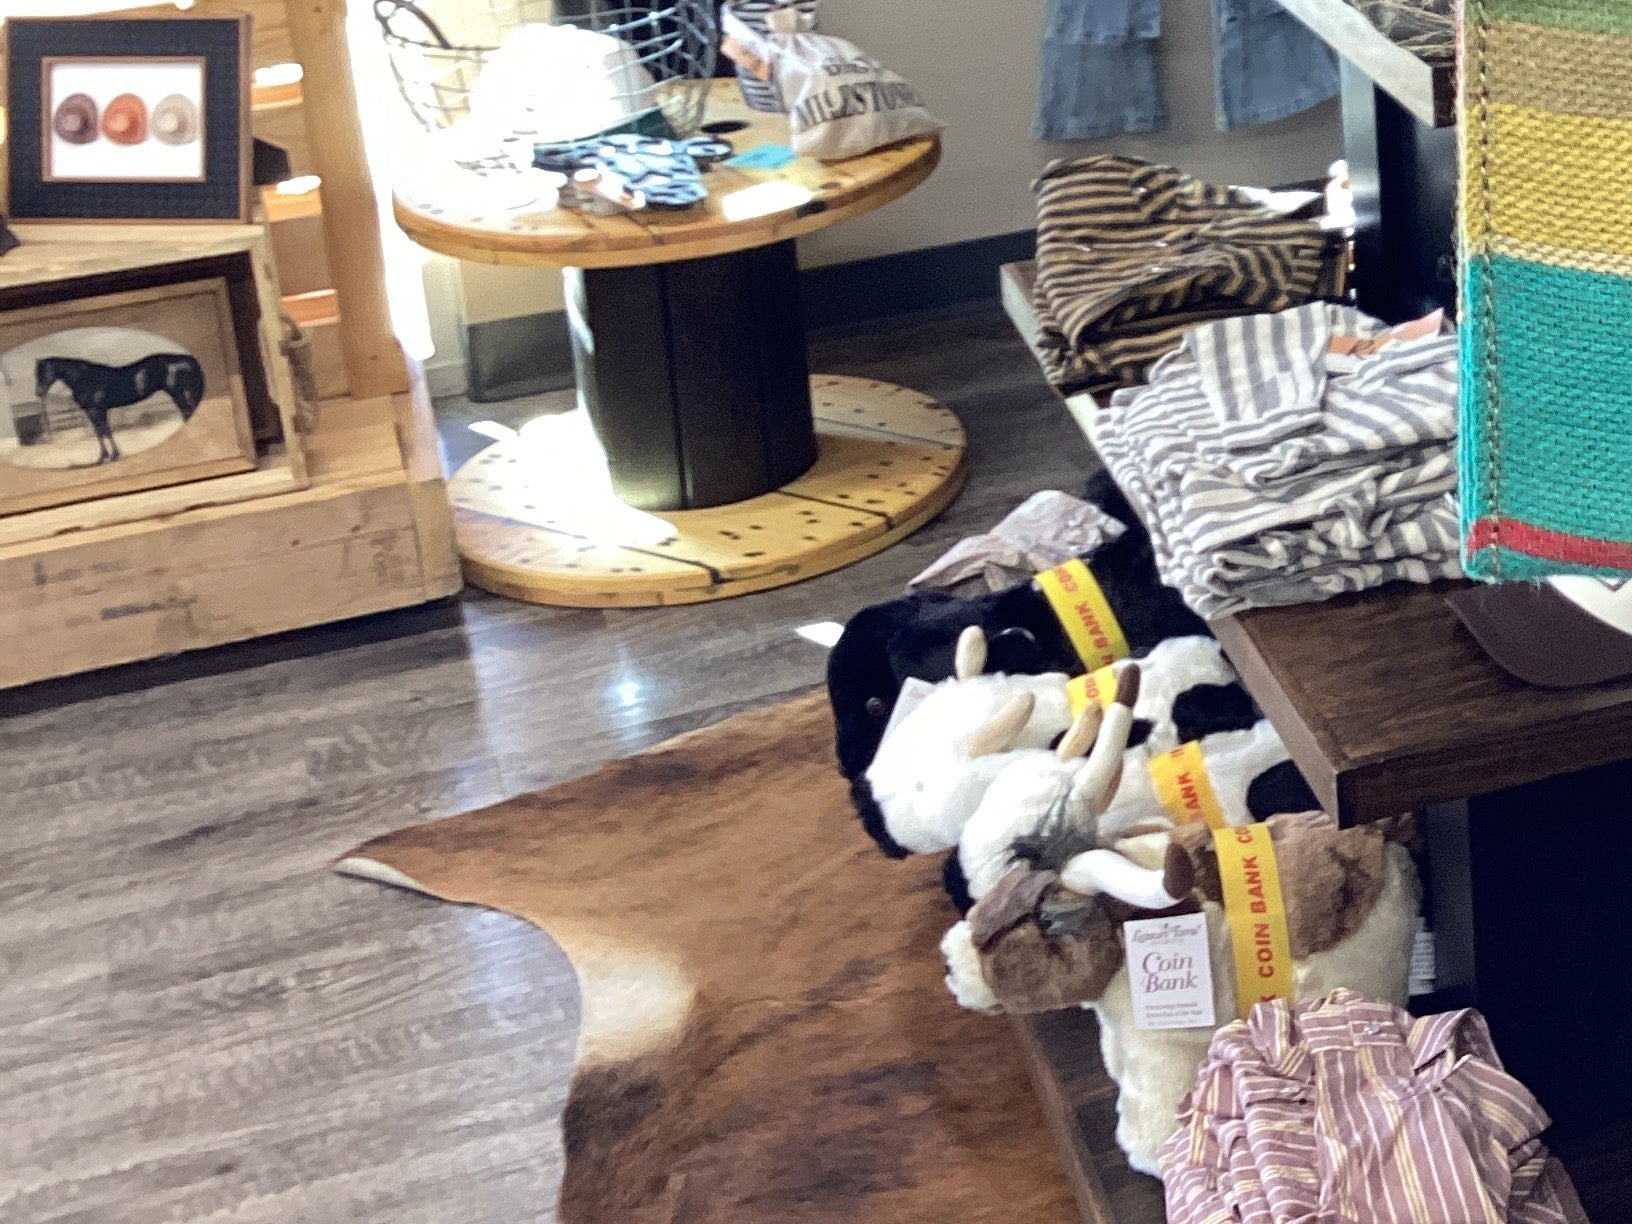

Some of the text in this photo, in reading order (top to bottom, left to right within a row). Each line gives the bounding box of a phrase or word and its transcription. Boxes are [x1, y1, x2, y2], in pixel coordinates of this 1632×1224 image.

[1241, 855, 1267, 914] BANK
[1142, 952, 1193, 976] Coin
[1255, 923, 1275, 979] COIN
[1145, 970, 1199, 993] Bank
